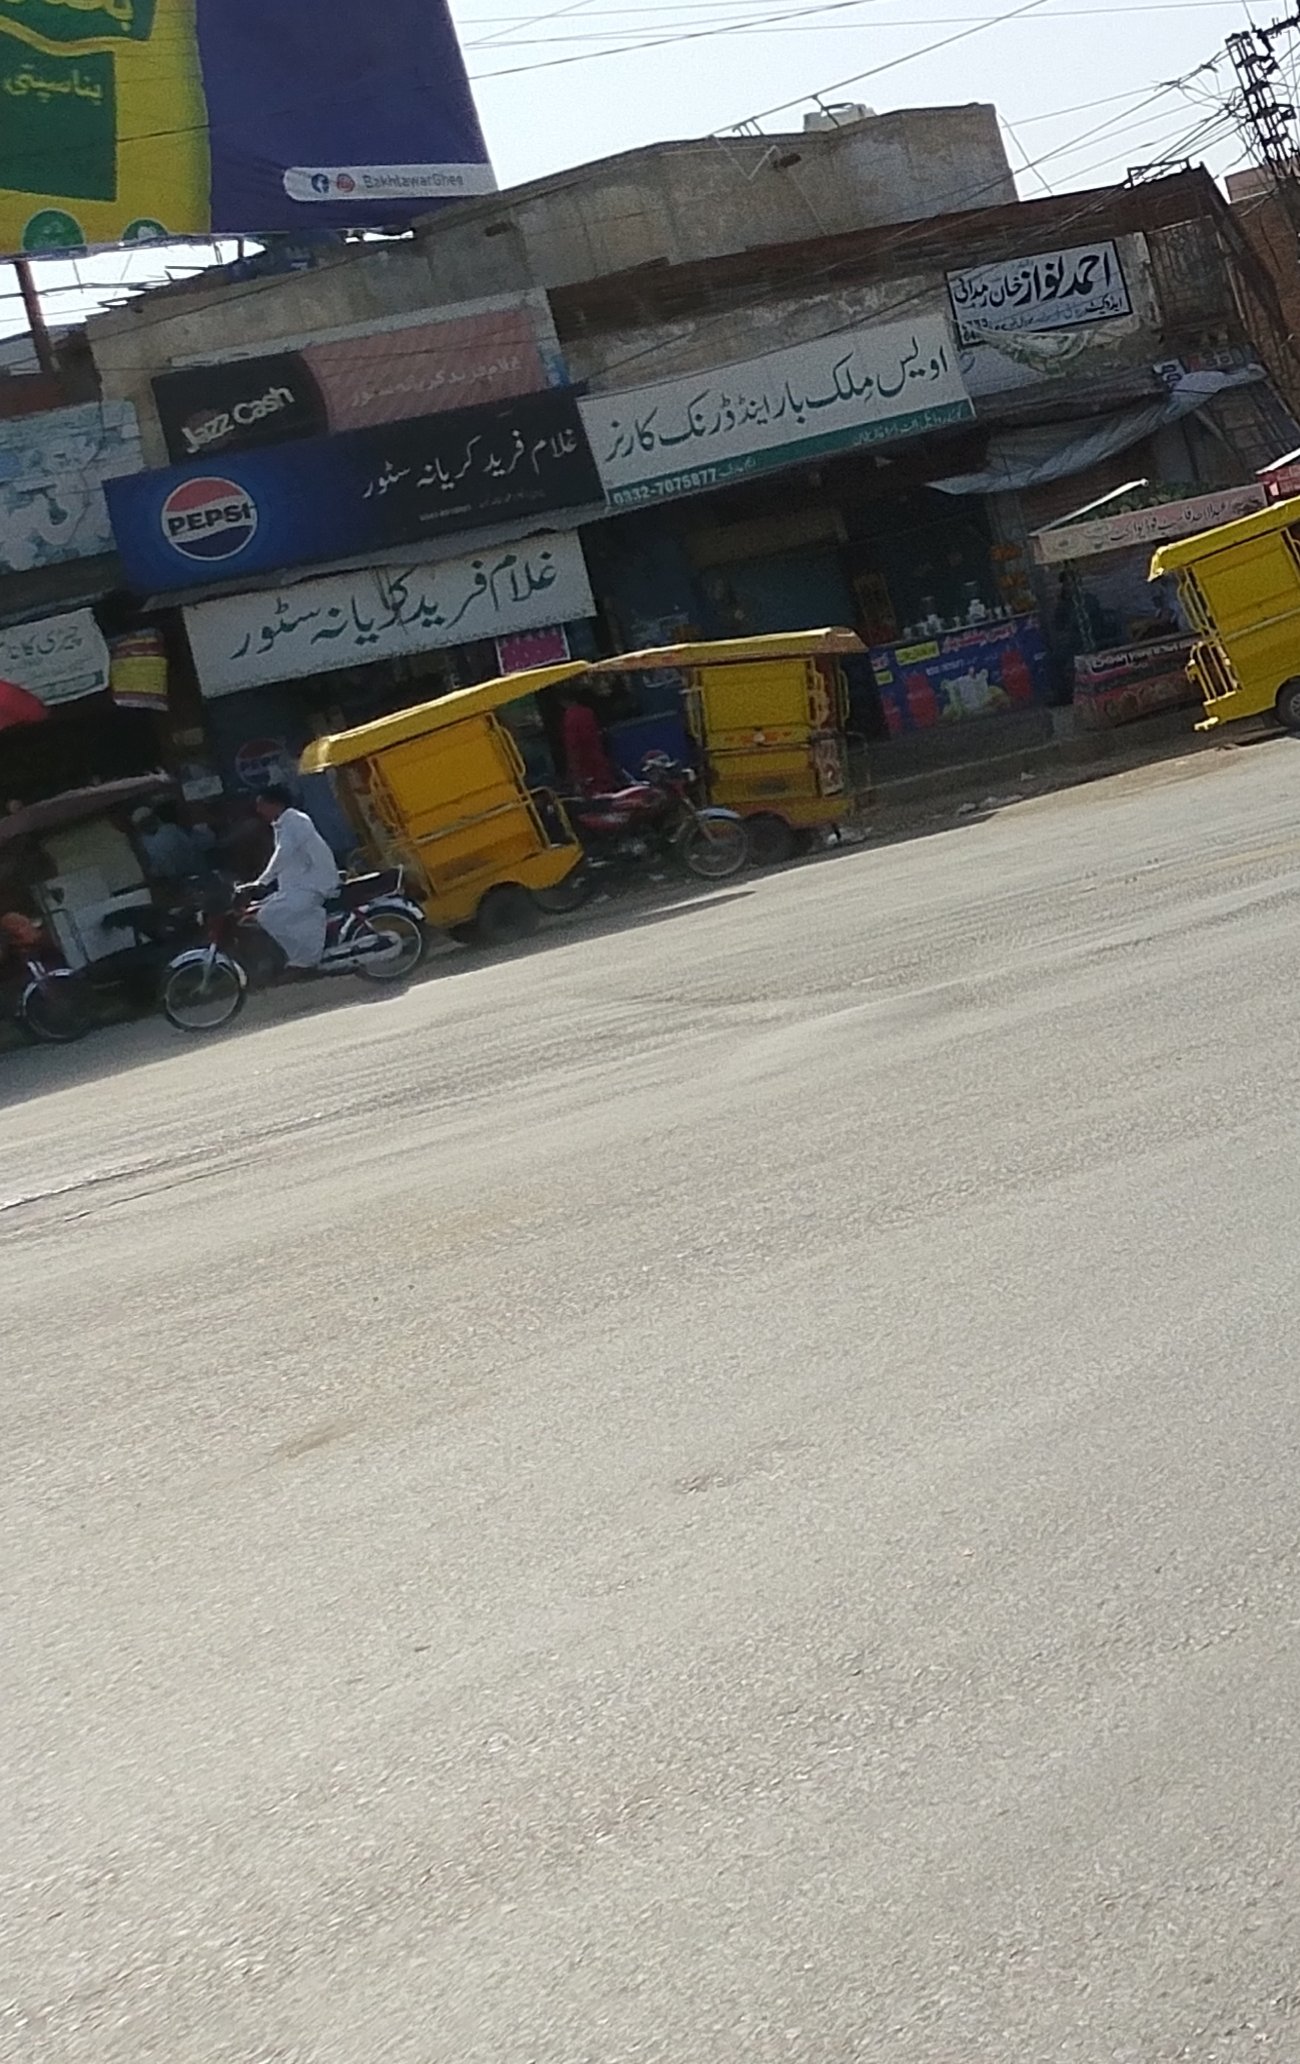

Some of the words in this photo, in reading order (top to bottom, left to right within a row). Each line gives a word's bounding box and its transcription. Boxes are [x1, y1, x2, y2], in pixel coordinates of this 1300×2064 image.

[989, 274, 1022, 308] خان
[1013, 255, 1064, 306] نواز
[1058, 251, 1111, 299] احمد
[877, 336, 948, 398] اویس
[658, 388, 735, 447] ڈرنک
[773, 380, 804, 424] بار
[483, 429, 525, 477] فرید
[531, 427, 578, 475] غلام
[605, 406, 659, 463] کارنر
[362, 460, 412, 499] سٹور
[416, 434, 483, 491] کریانہ
[167, 501, 255, 537] PEPSI
[401, 558, 491, 631] فرید
[490, 550, 558, 612] غلام
[230, 596, 320, 661] سٹور
